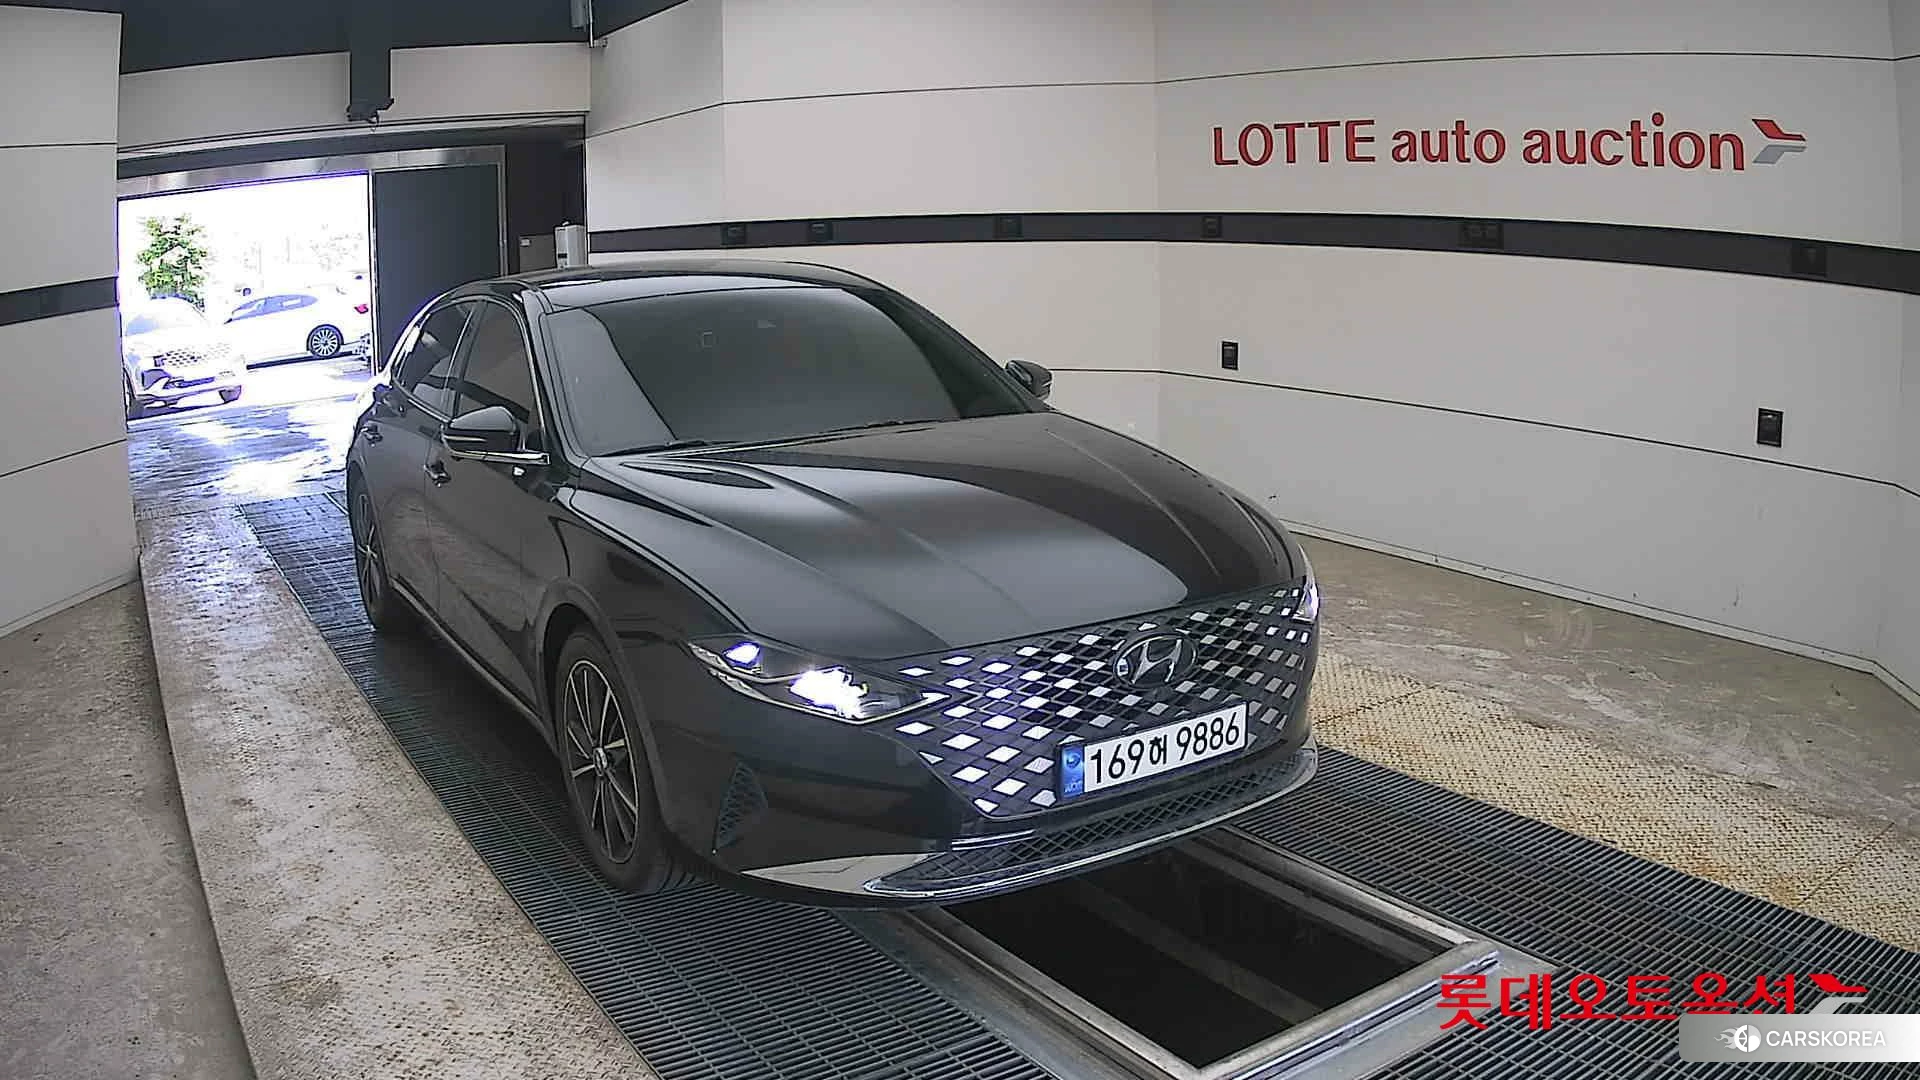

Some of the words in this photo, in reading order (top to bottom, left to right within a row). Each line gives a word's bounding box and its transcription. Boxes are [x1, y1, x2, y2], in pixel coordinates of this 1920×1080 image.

[1213, 119, 1377, 166] LOTTE
[1391, 119, 1507, 164] auto
[1522, 112, 1745, 171] auction
[1090, 734, 1168, 784] 169허
[1176, 711, 1240, 762] 9886
